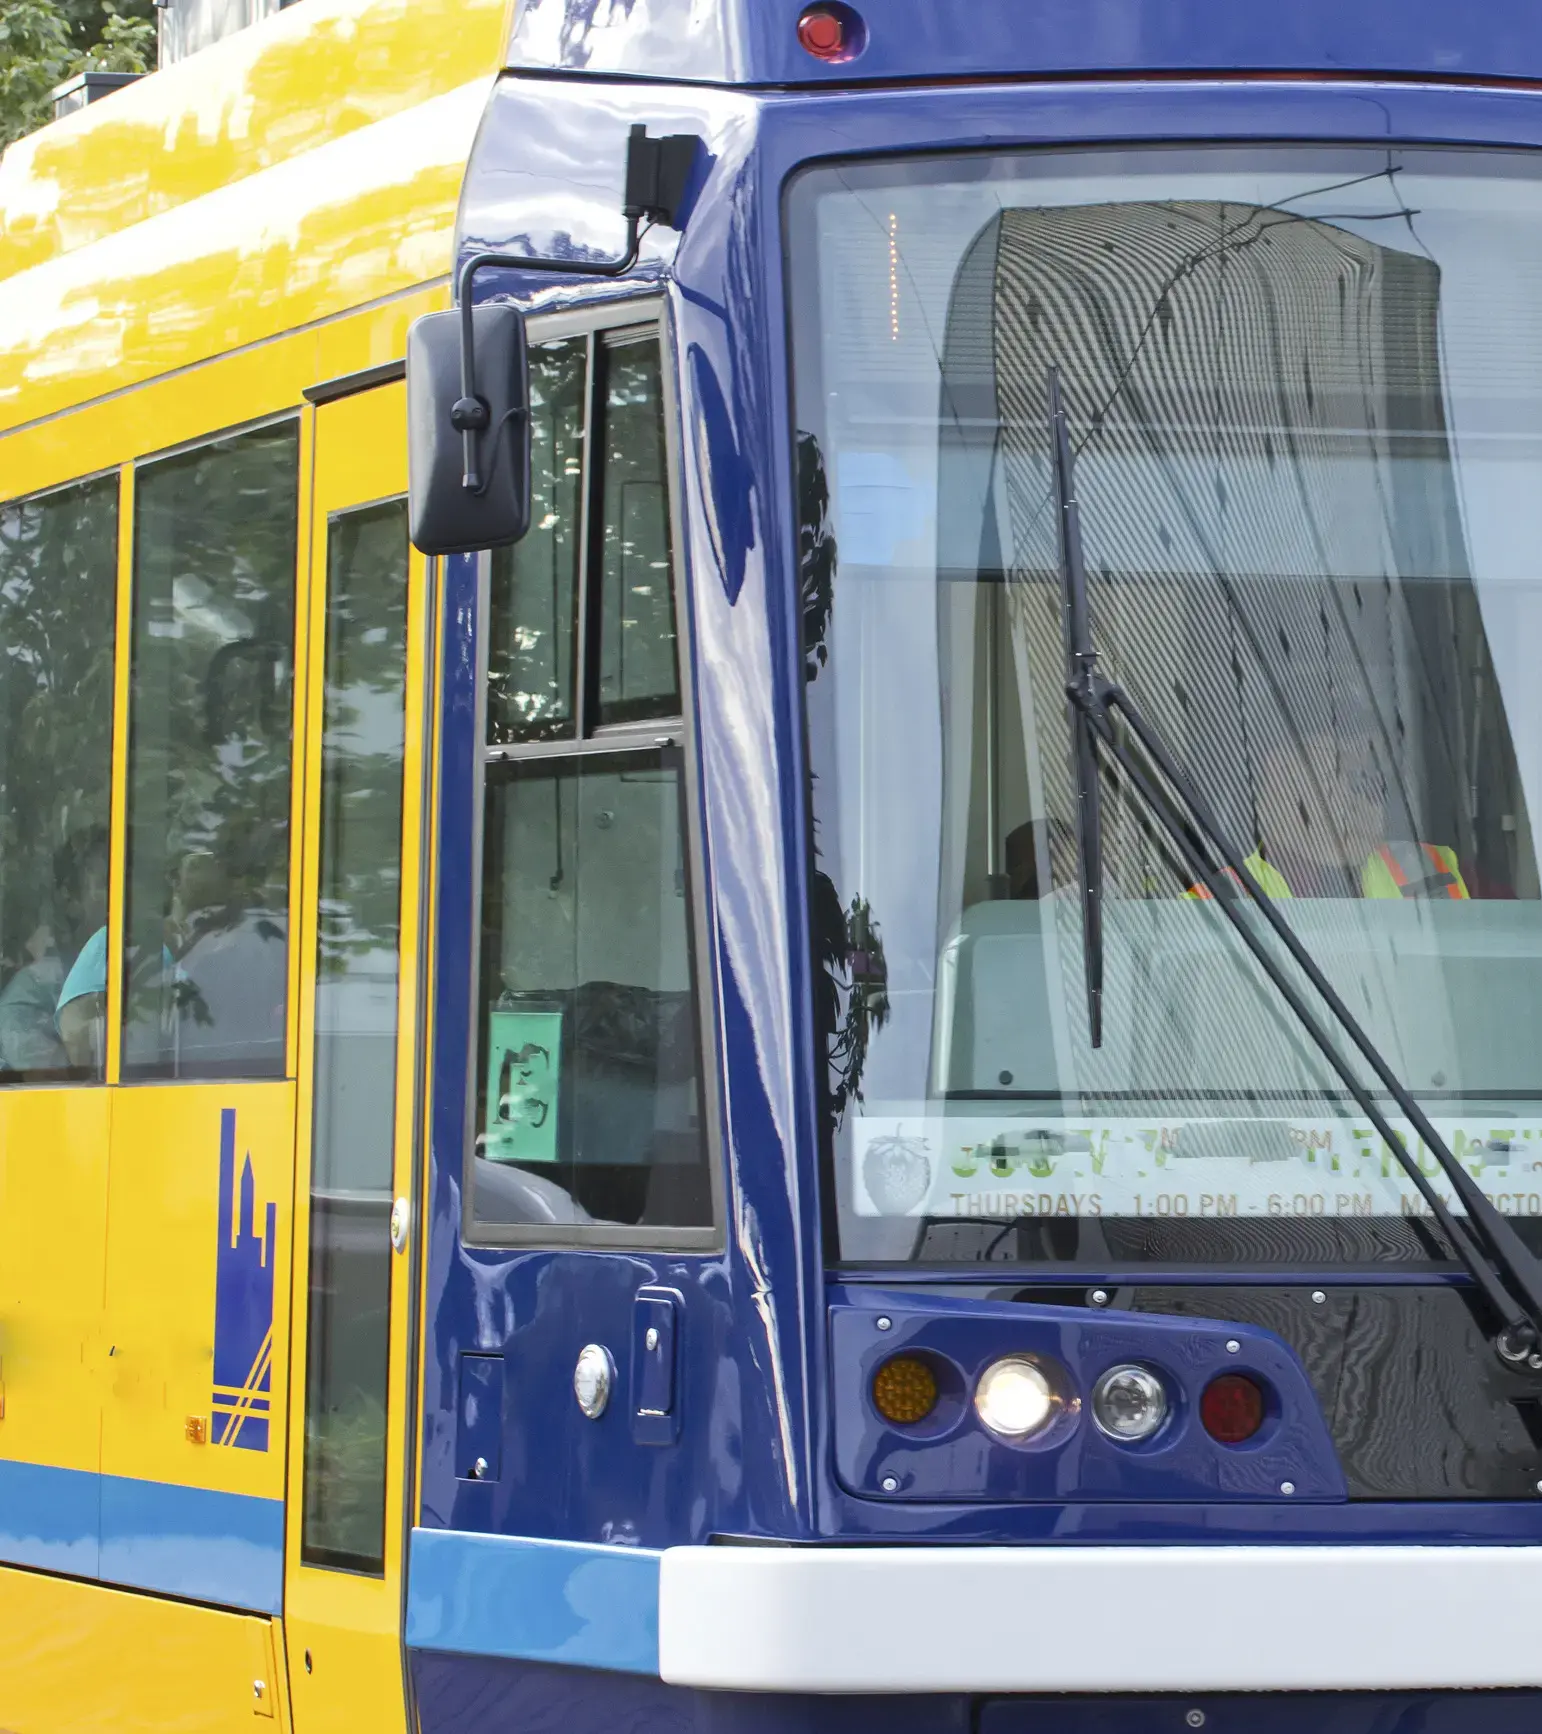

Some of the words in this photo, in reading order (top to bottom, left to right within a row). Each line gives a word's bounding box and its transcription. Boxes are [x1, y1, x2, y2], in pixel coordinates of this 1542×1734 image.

[949, 1192, 1102, 1217] THURSDAYS
[1133, 1193, 1189, 1217] 1:00
[1199, 1193, 1238, 1217] PM
[1266, 1193, 1325, 1217] 6:00
[1335, 1193, 1374, 1217] PM
